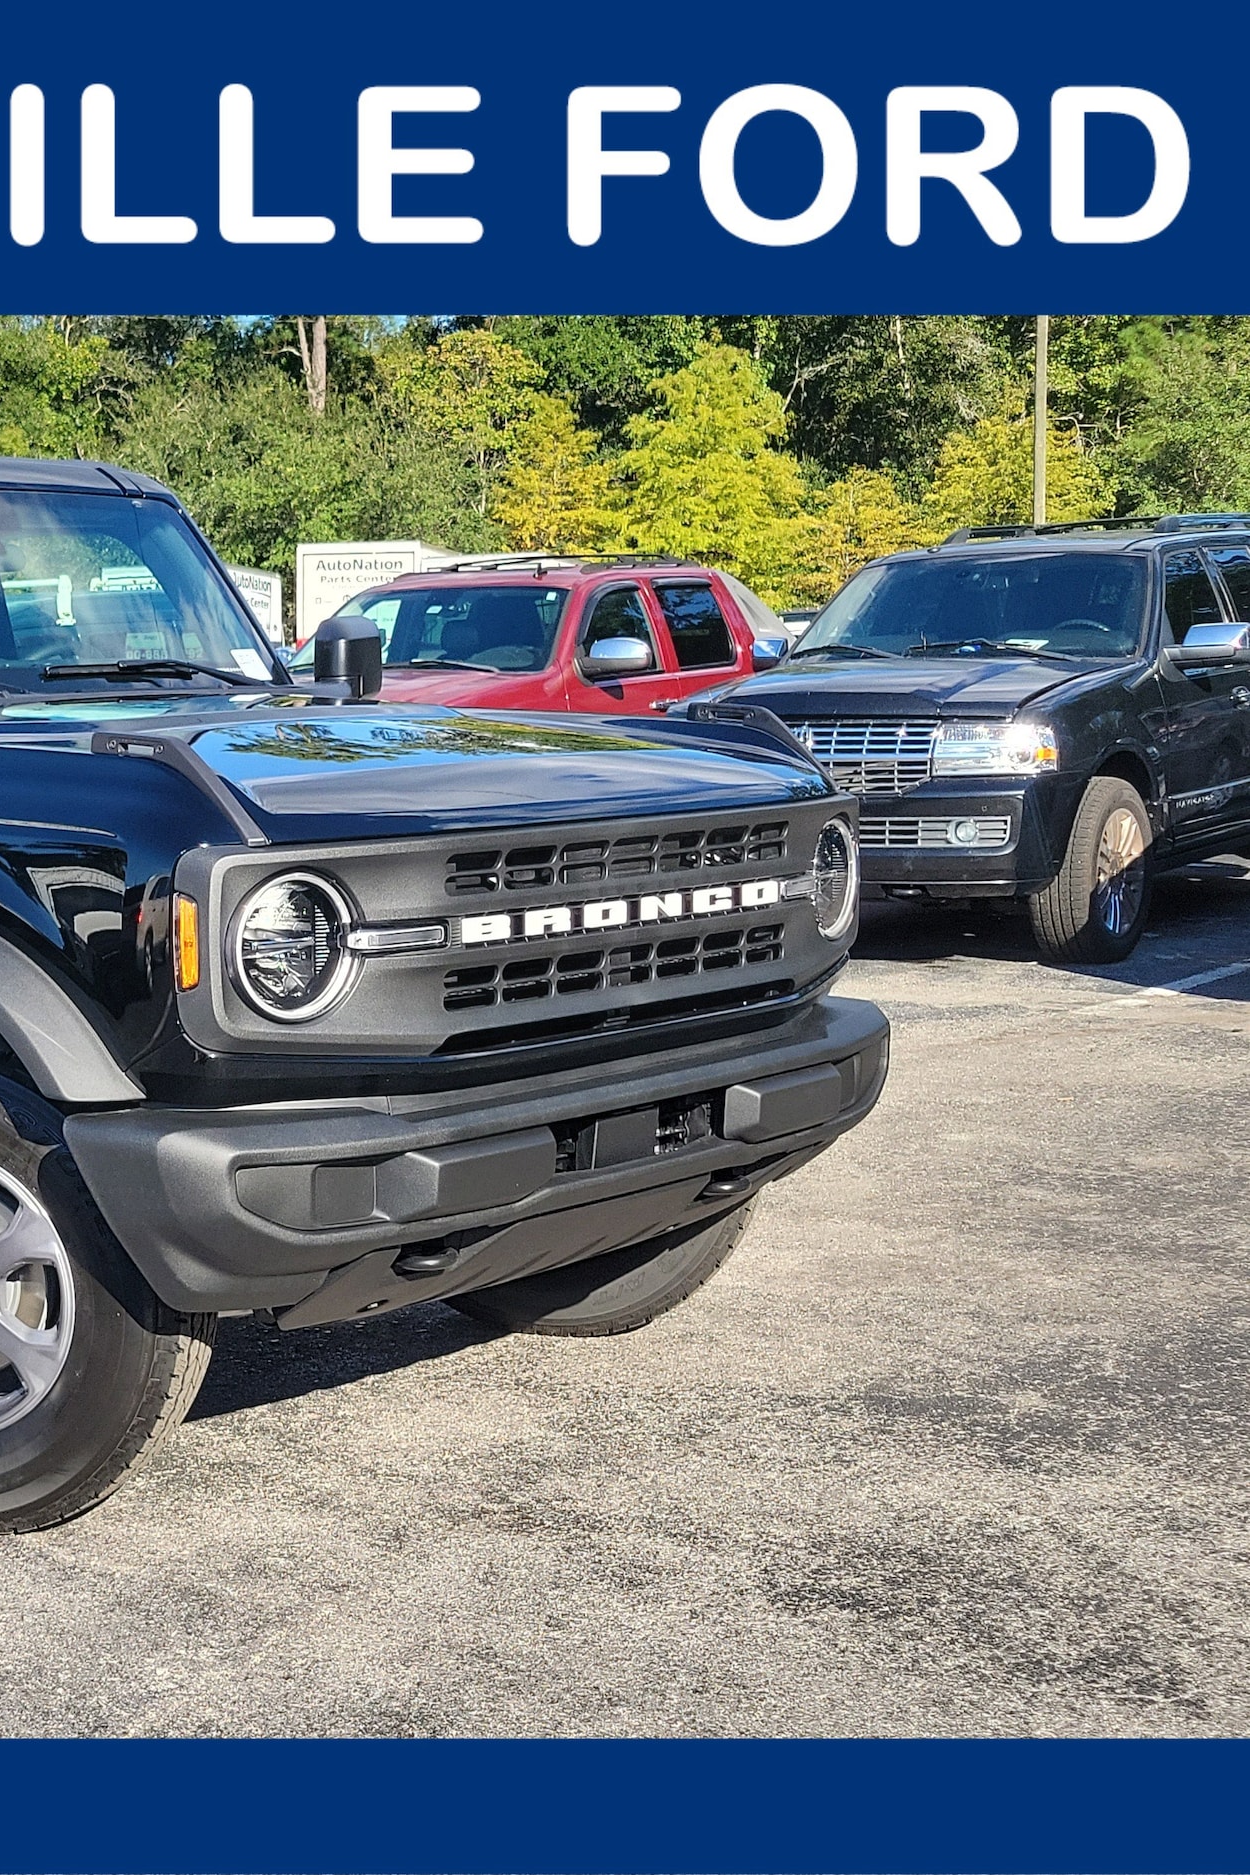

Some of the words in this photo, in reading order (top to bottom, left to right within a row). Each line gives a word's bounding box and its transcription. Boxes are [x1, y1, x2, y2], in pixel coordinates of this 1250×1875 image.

[316, 558, 403, 572] AutoNation
[321, 575, 351, 584] Parts
[461, 880, 779, 944] BRONCO
